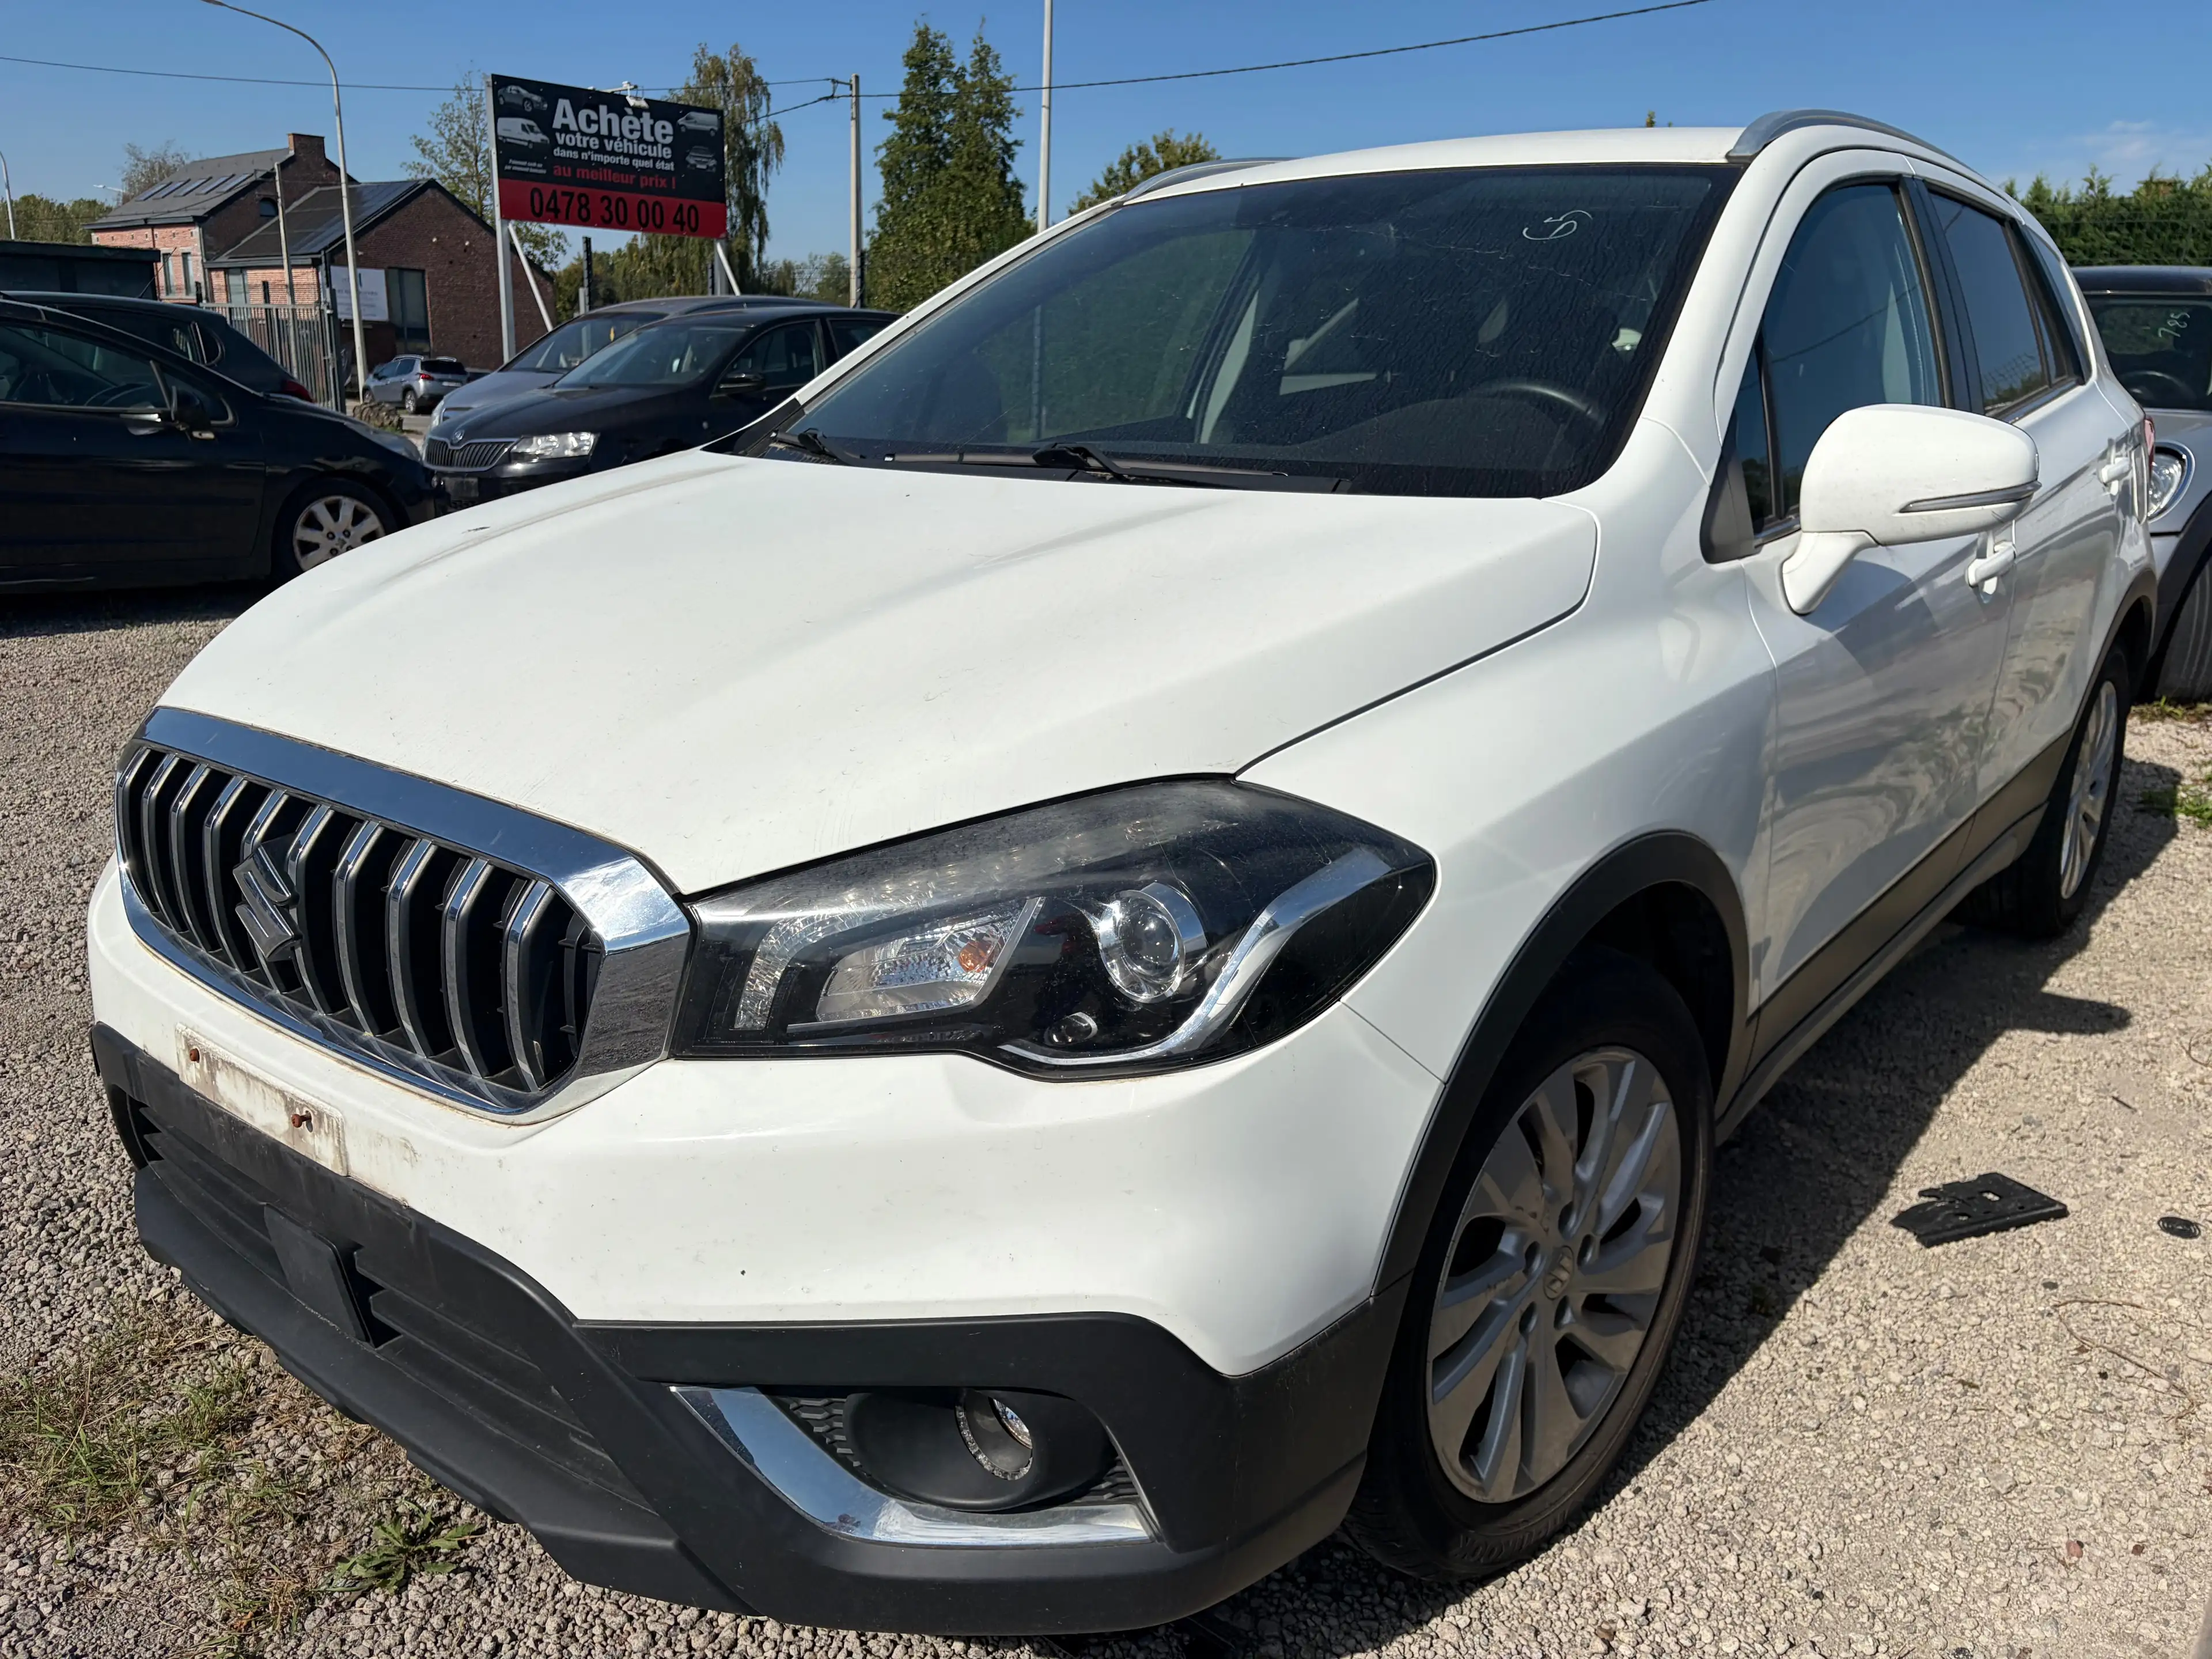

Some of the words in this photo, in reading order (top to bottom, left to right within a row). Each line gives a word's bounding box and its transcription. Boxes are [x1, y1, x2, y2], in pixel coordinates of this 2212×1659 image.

[552, 98, 674, 144] Achète
[553, 147, 579, 159] dans
[581, 150, 630, 165] n'importe
[632, 158, 653, 169] quel
[655, 160, 675, 171] état
[555, 132, 600, 150] votre
[604, 137, 672, 159] véhicule
[553, 165, 572, 177] au
[576, 168, 636, 185] meilleur
[639, 175, 667, 188] prix
[672, 176, 676, 189] !
[530, 187, 591, 222] 0478
[600, 195, 628, 226] 30
[637, 199, 664, 229] 00
[672, 203, 699, 233] 40
